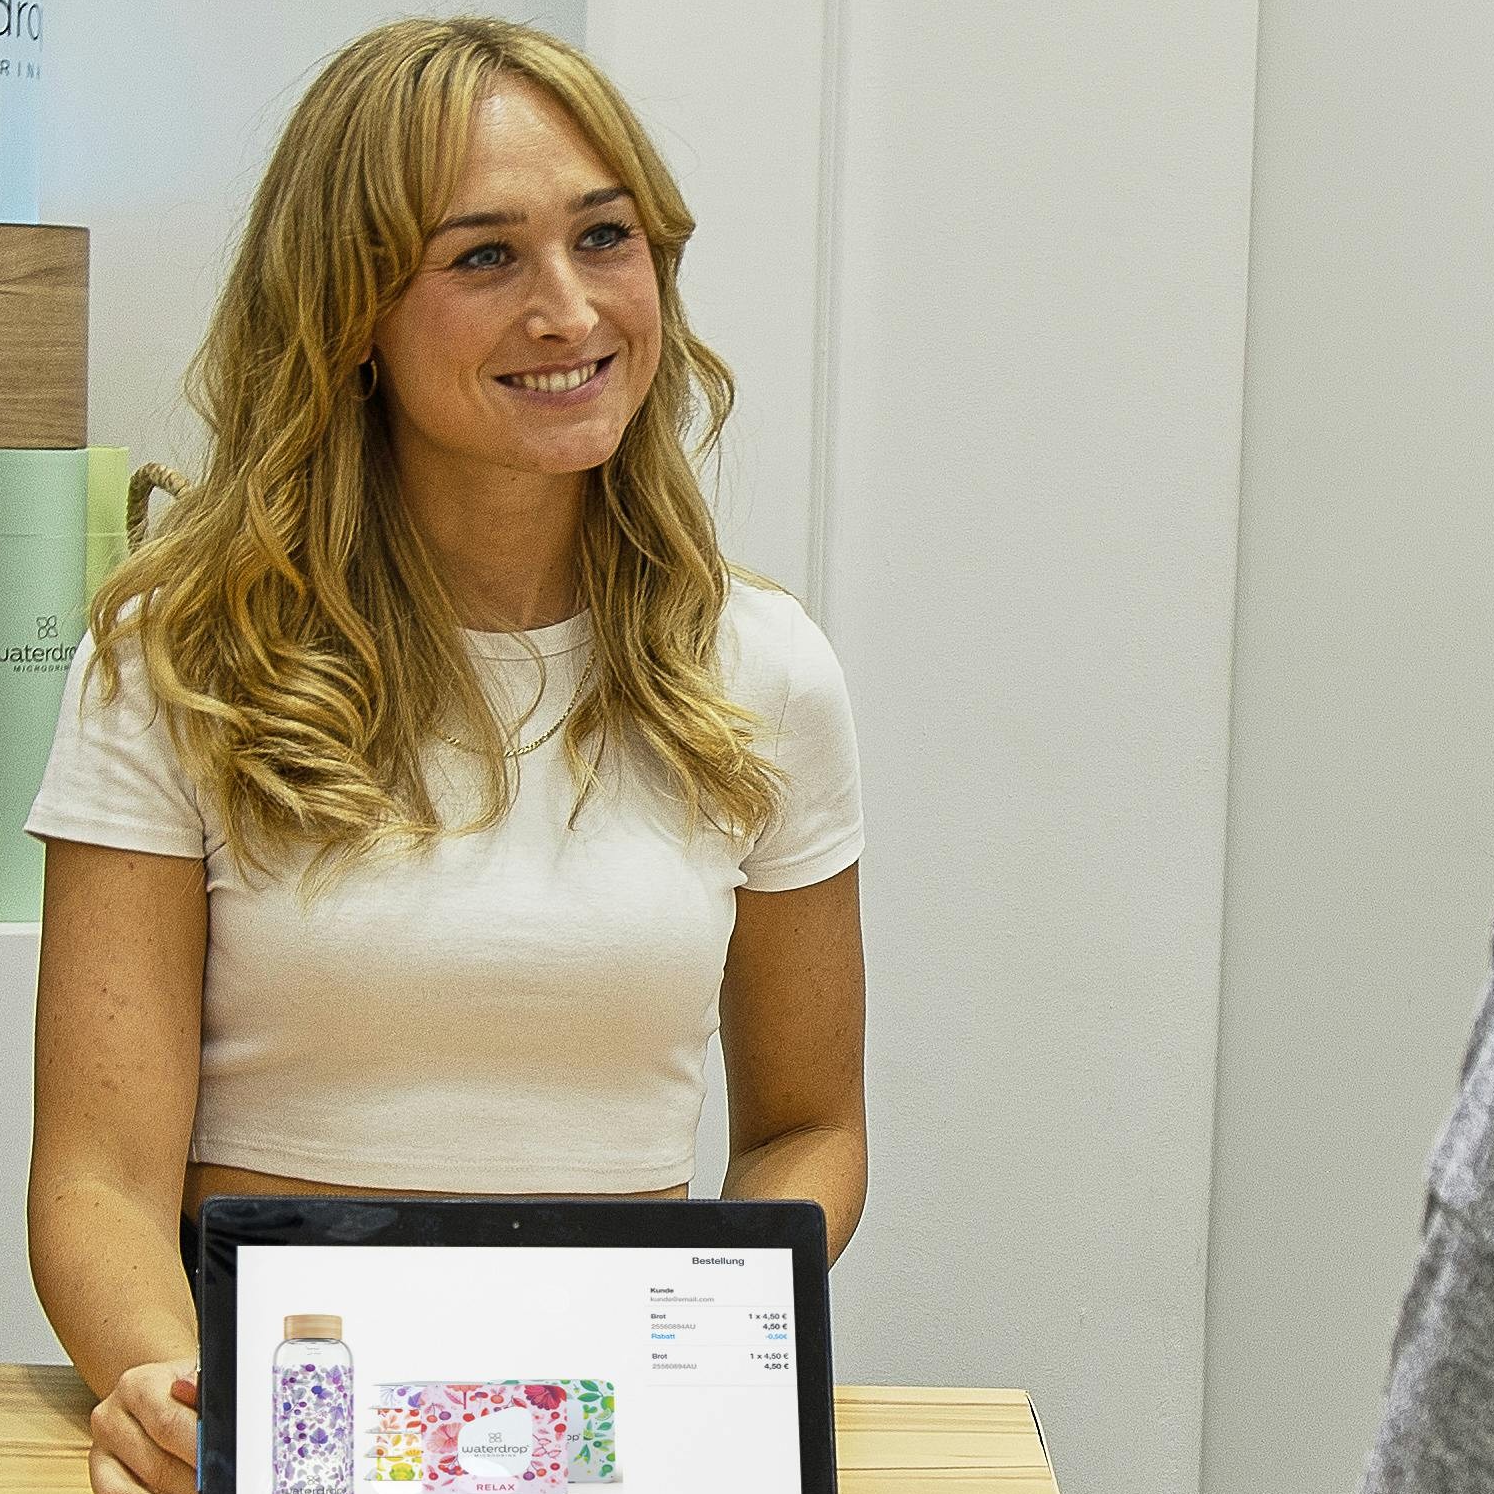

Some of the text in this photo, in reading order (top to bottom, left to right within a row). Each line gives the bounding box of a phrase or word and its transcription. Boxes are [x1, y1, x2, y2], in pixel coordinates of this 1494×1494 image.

[692, 1257, 745, 1267] Bestellung
[763, 1313, 780, 1321] 4,50
[763, 1323, 780, 1331] 4,50
[764, 1353, 782, 1361] 4,50
[764, 1363, 782, 1371] 4,50
[461, 1444, 528, 1454] waterdrop
[476, 1483, 516, 1491] RELAX
